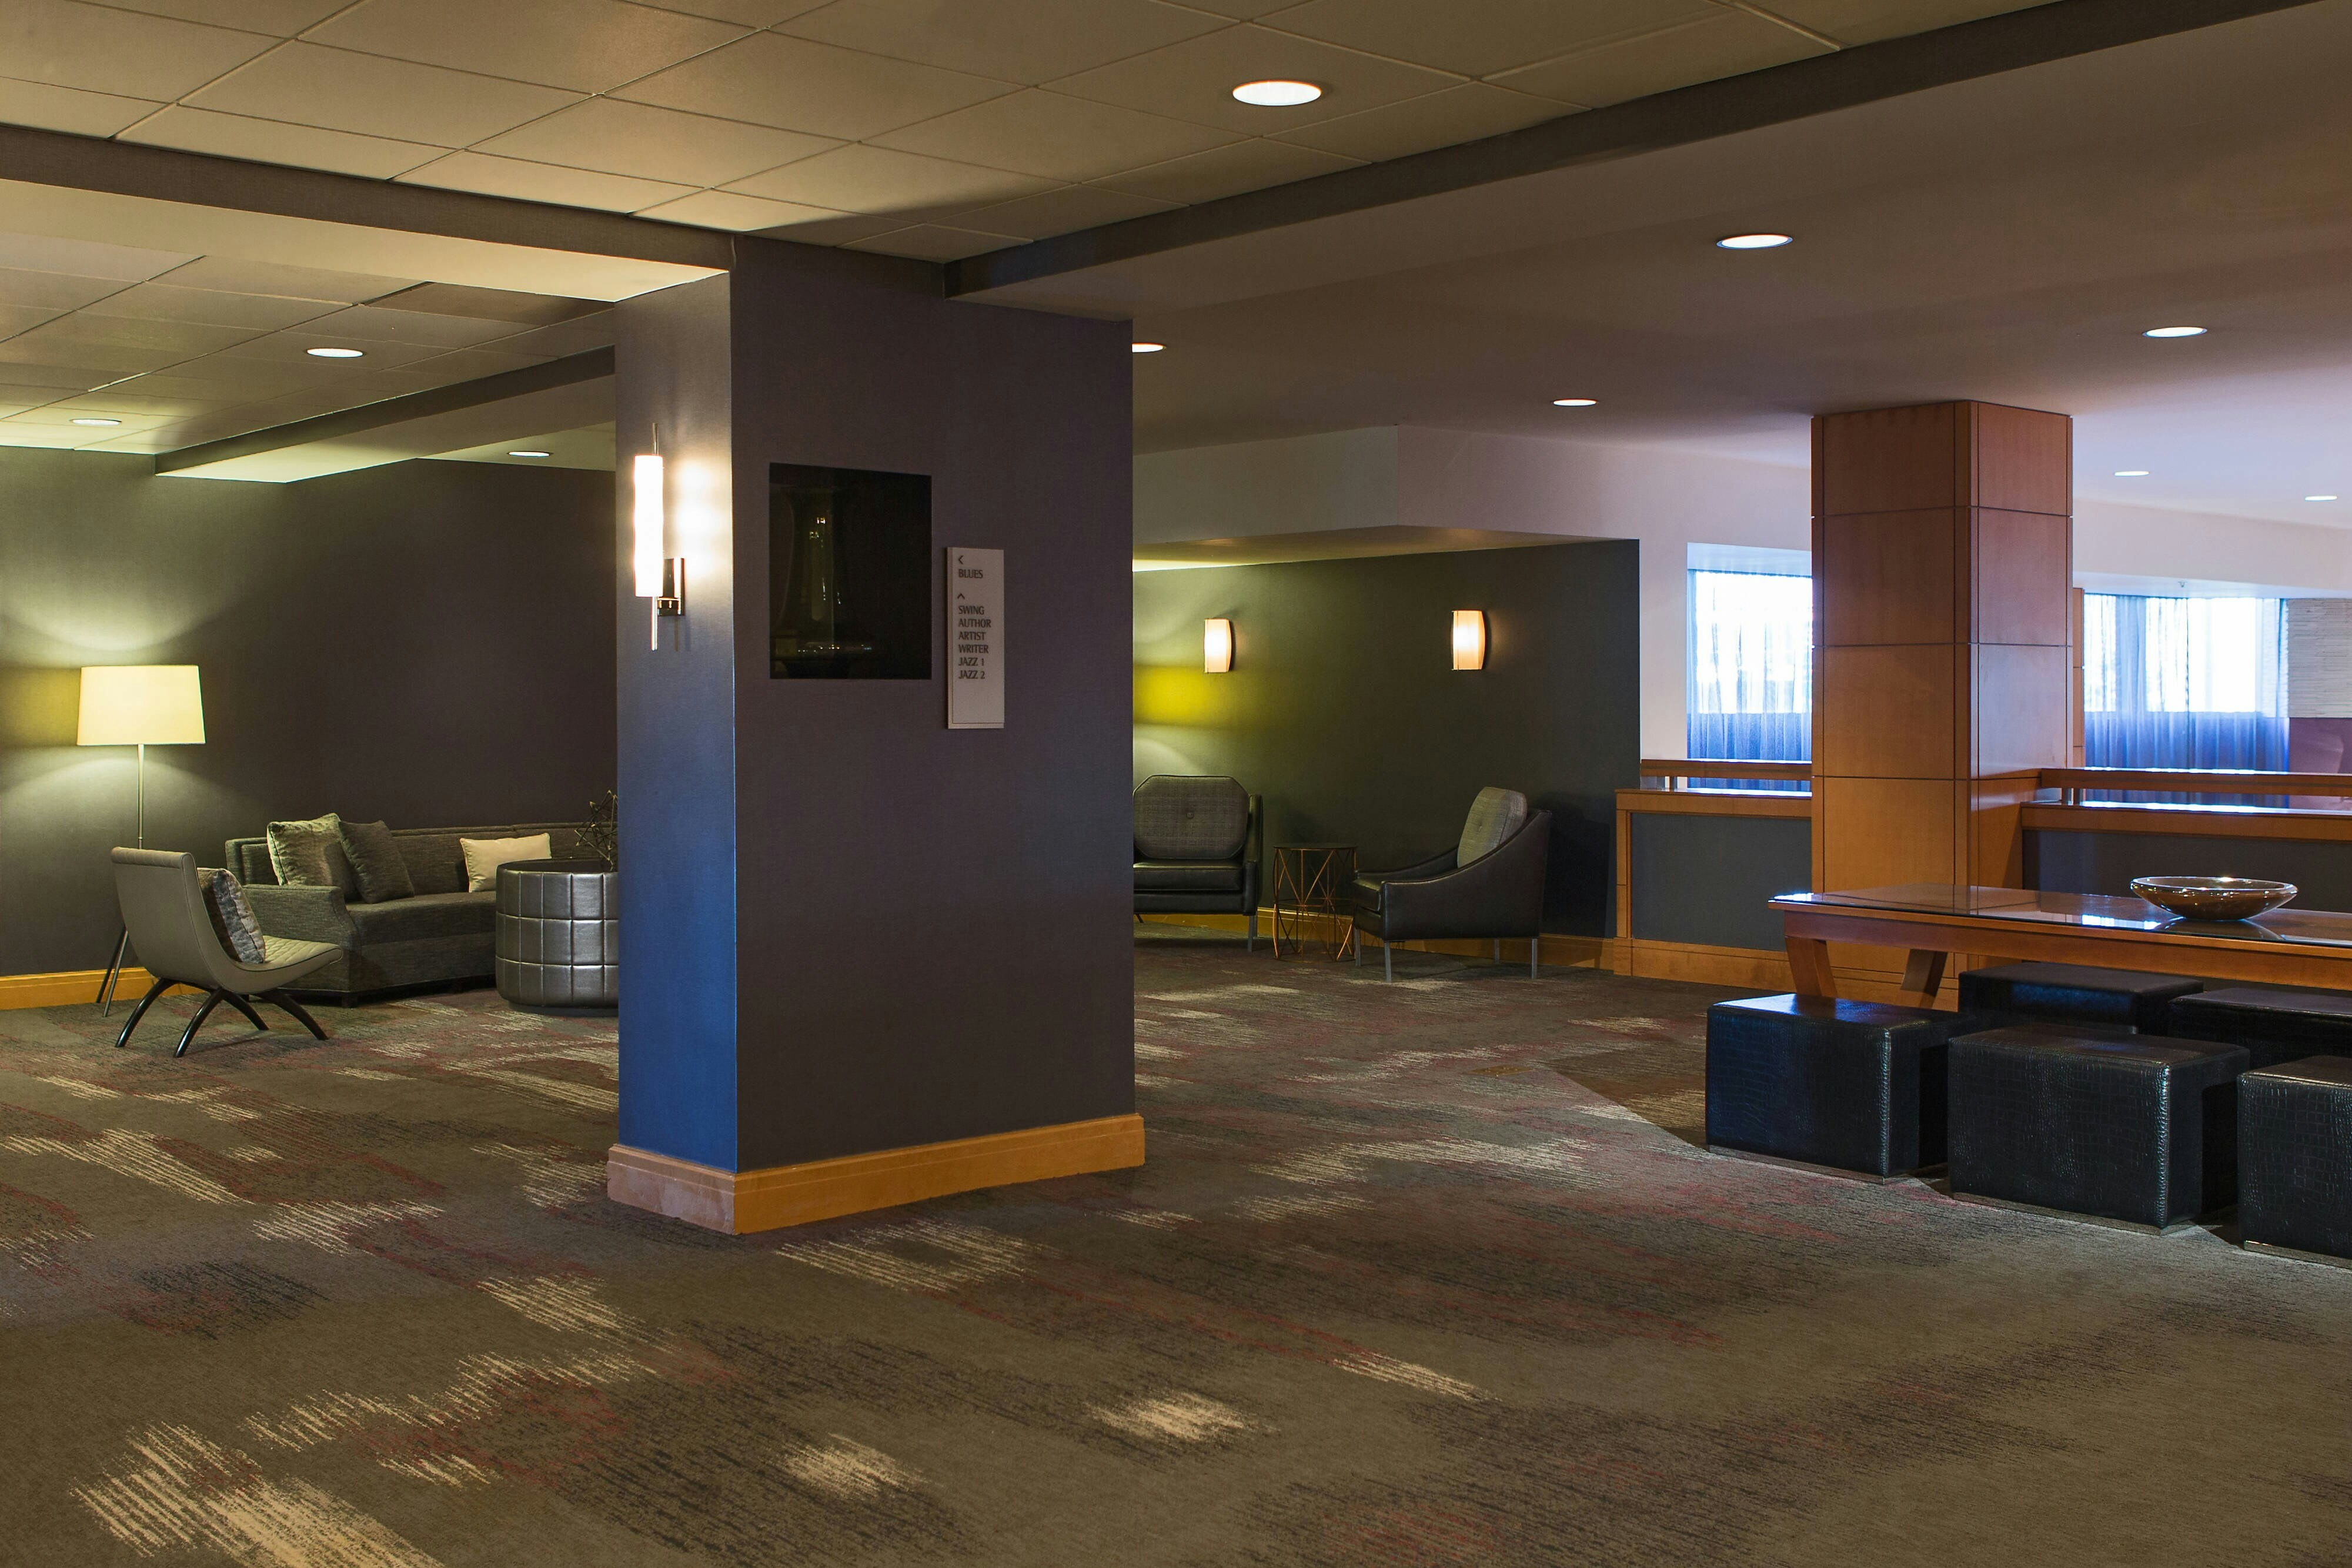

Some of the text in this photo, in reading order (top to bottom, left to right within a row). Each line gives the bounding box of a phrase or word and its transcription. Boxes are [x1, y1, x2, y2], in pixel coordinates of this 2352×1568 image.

[958, 569, 983, 579] BLUES
[958, 606, 984, 615] SWING
[958, 618, 991, 628] AUTHOR
[958, 631, 986, 640] ARTIST
[958, 644, 989, 654] WRITER
[958, 657, 984, 666] JAZZ 1
[958, 670, 985, 679] JAZZ 2
